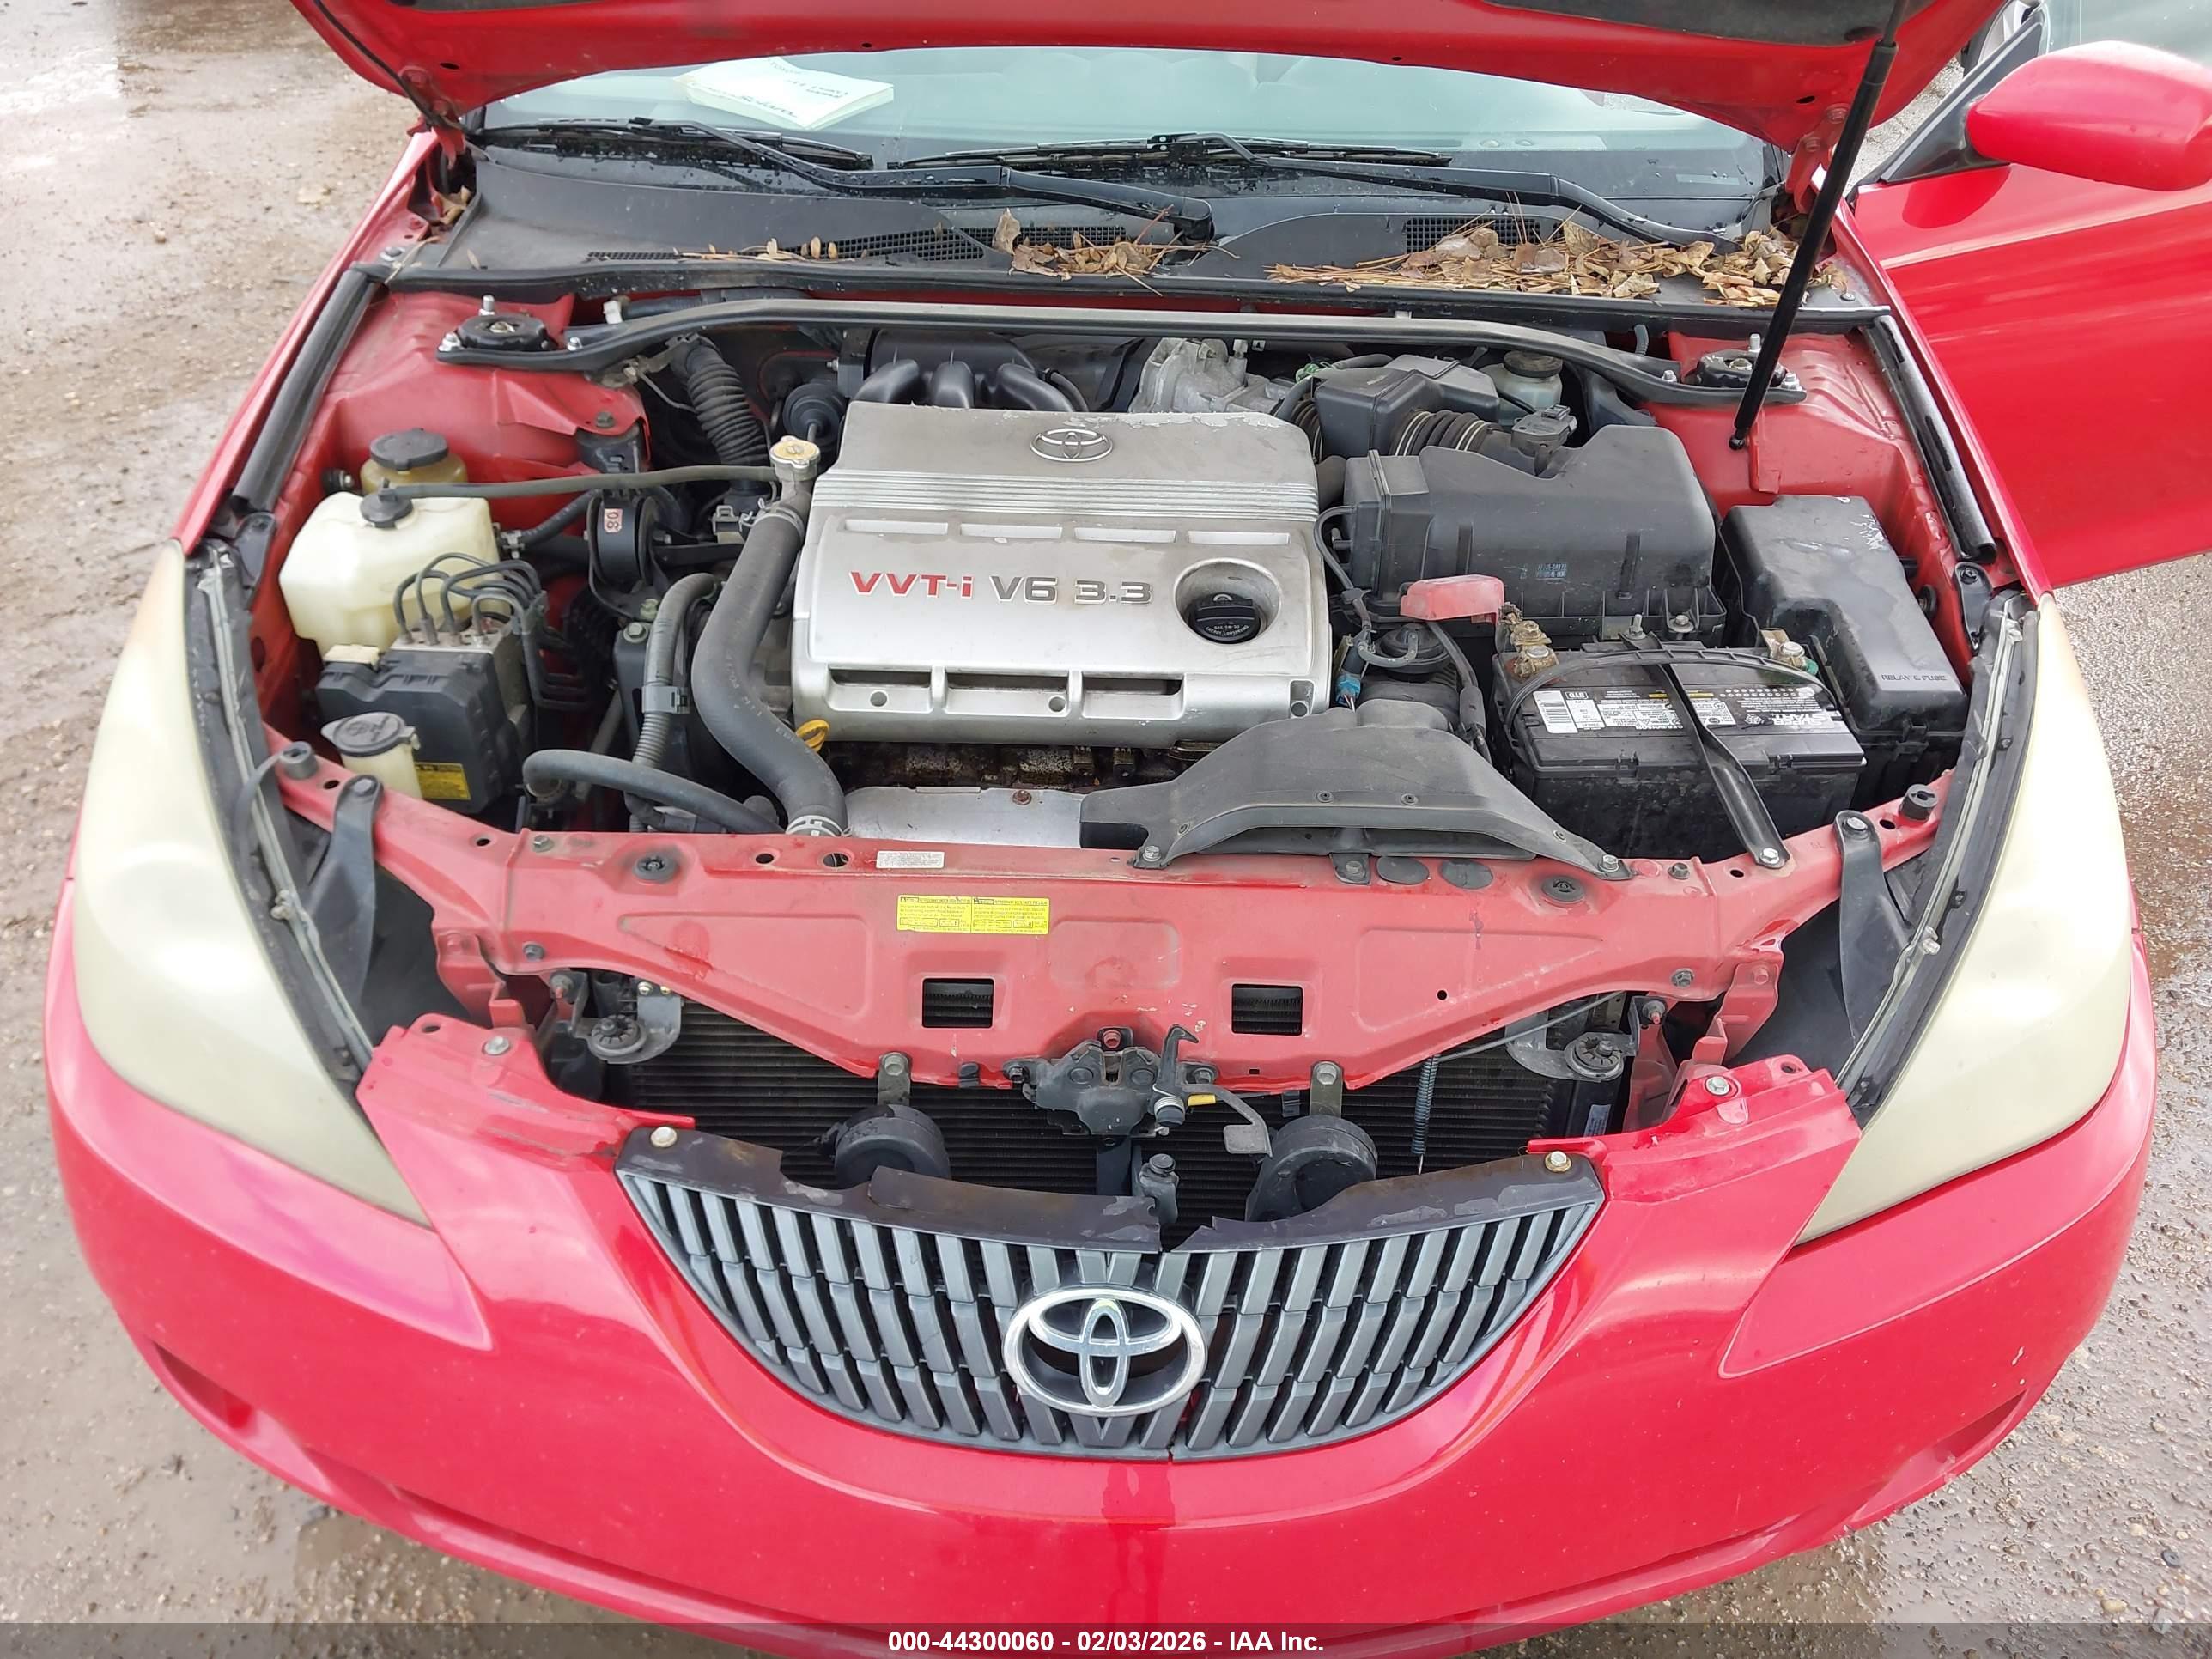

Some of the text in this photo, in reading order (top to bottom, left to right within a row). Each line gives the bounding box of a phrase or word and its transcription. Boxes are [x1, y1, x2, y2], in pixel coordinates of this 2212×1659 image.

[850, 571, 1154, 605] VVT-i V6 3.3
